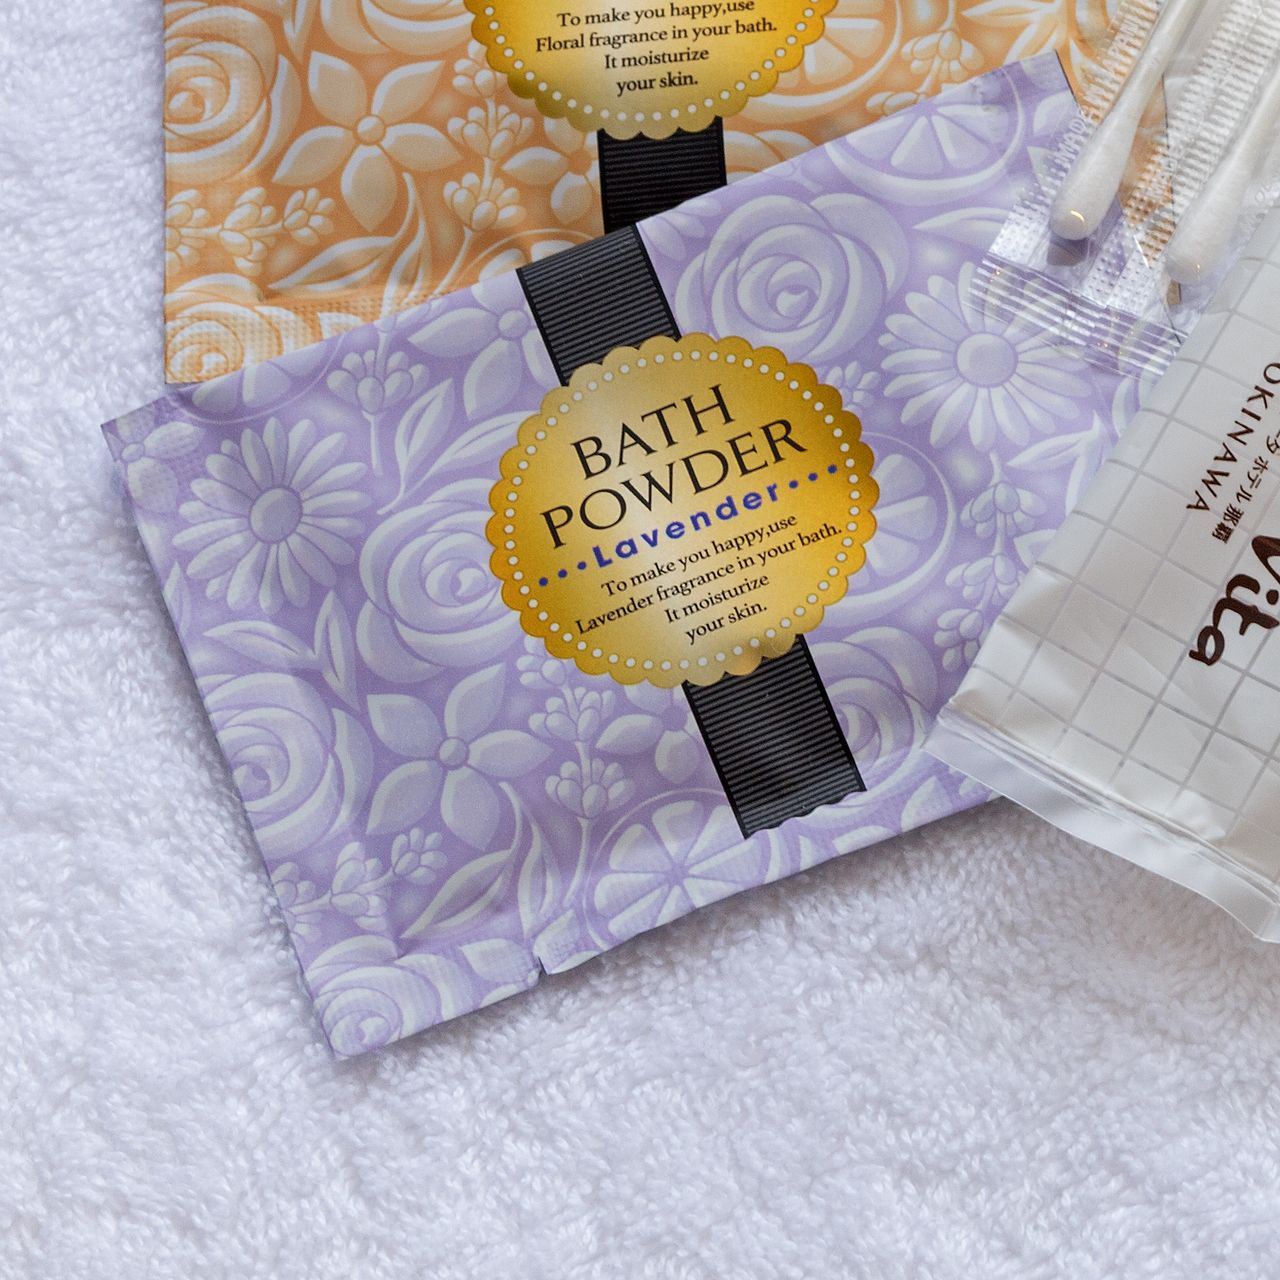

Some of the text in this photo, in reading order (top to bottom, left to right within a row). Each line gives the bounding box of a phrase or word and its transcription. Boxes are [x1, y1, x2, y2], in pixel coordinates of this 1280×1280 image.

[535, 17, 778, 53] Floral fragrance in your bath.
[556, 12, 581, 28] To
[585, 8, 631, 25] make
[633, 7, 666, 24] you
[604, 47, 710, 70] It moisturize
[616, 71, 699, 97] your skin.
[570, 383, 735, 481] BATH
[540, 419, 807, 549] POWDER
[592, 481, 779, 568] Lavender
[575, 522, 842, 635] Lavender fragrance in your bath.
[600, 579, 628, 597] To
[630, 560, 677, 587] make
[678, 549, 710, 572] you
[663, 574, 770, 624] It moisturize
[685, 601, 768, 645] your skin.
